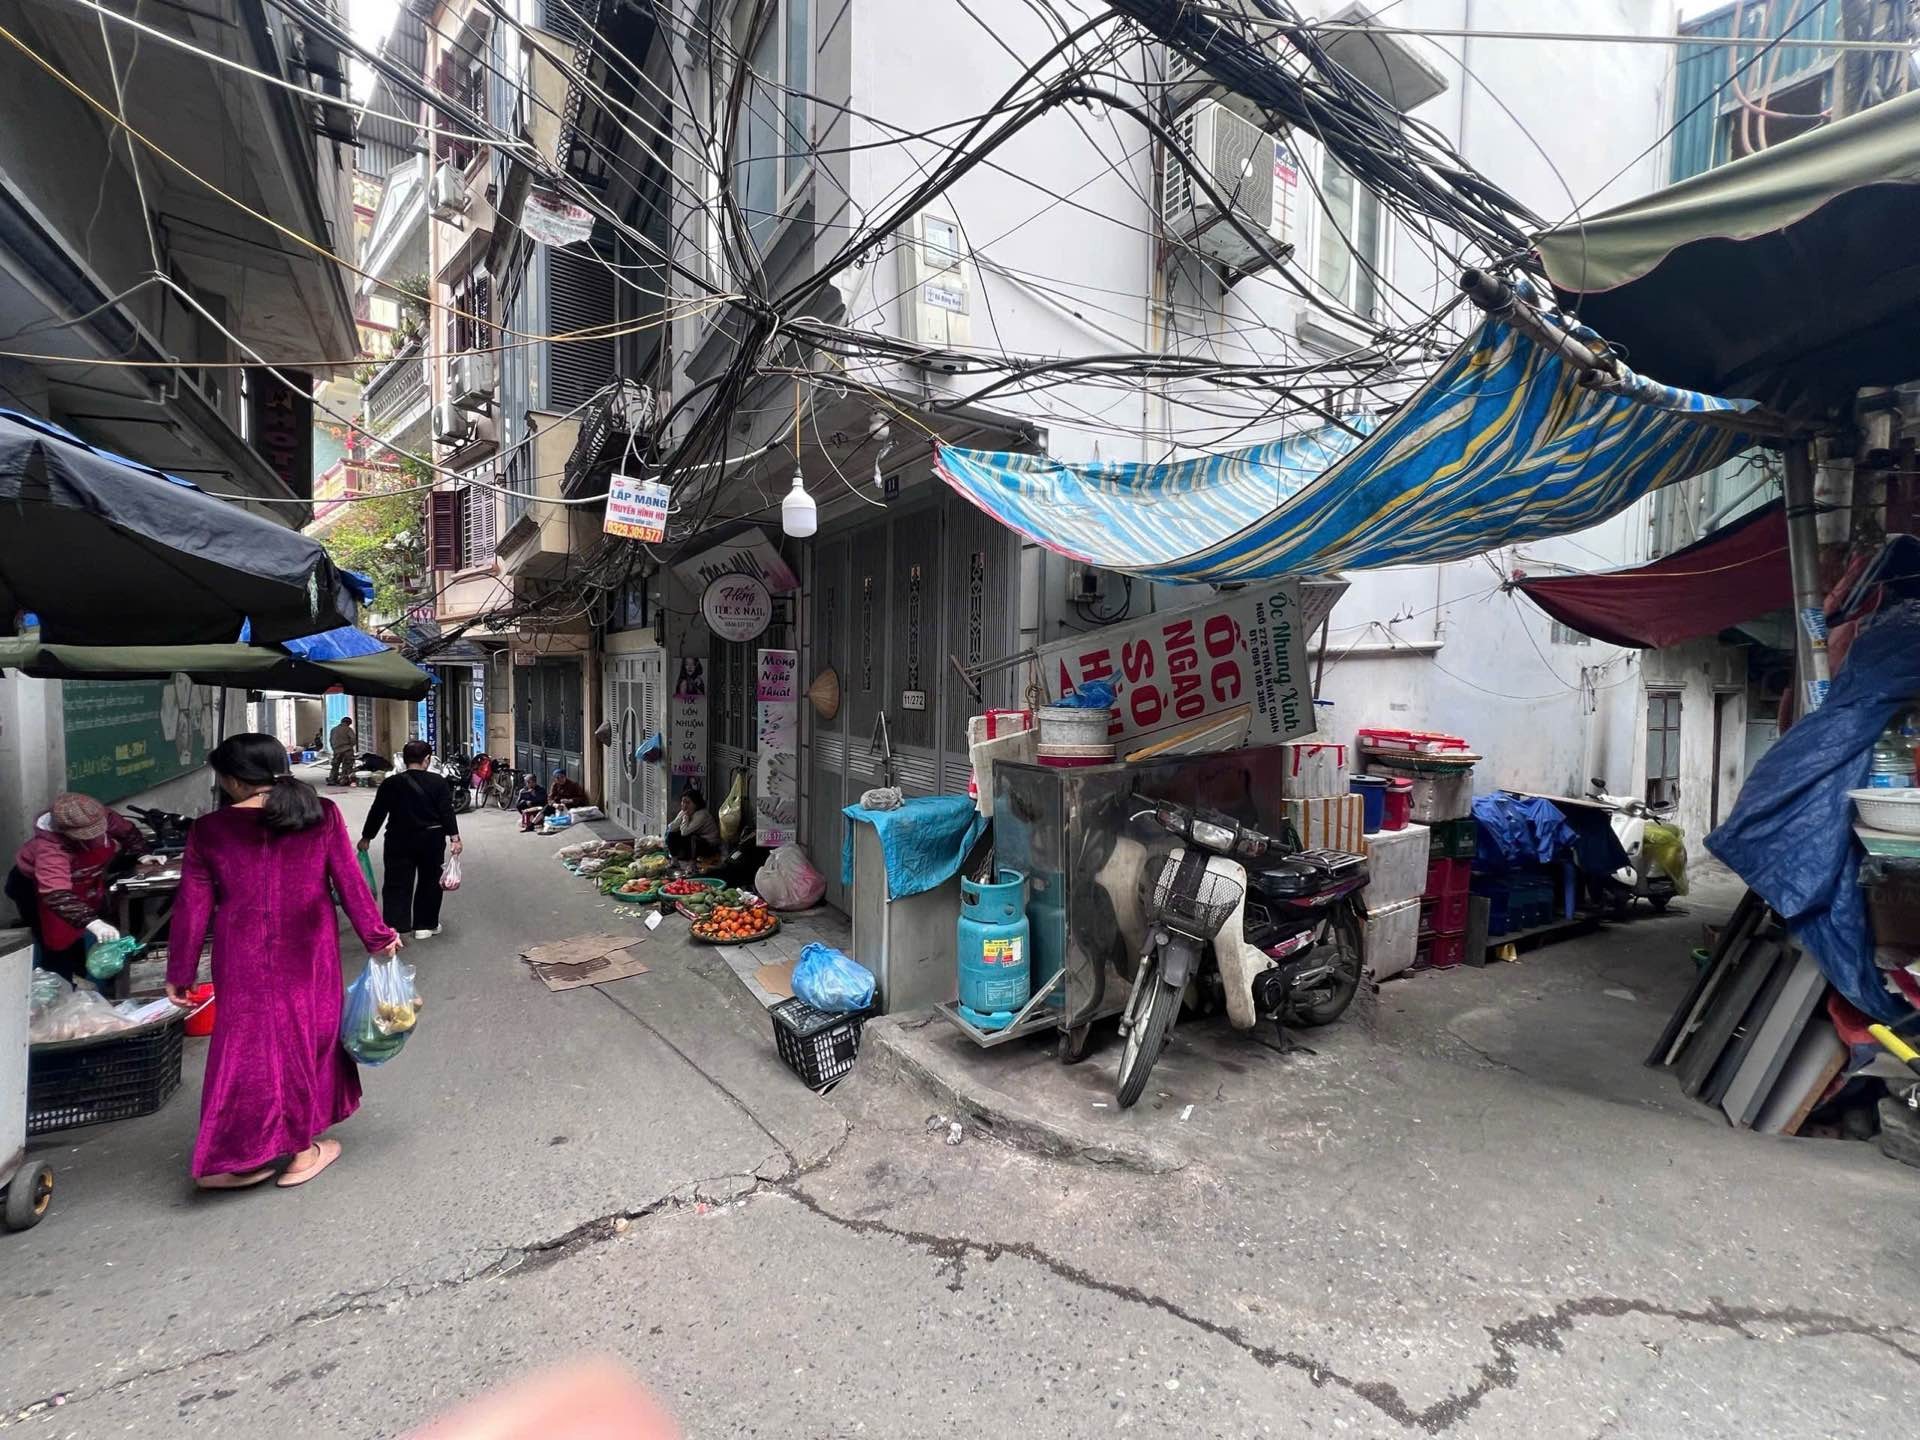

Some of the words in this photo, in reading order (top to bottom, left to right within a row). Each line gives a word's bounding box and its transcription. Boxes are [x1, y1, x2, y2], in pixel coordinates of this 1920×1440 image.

[634, 494, 667, 509] MẠNG
[655, 511, 665, 521] HD
[1204, 614, 1248, 702] ỐC
[1258, 628, 1268, 647] 272
[1272, 621, 1292, 688] Nhung
[1121, 639, 1168, 728] SÒ
[1162, 619, 1205, 720] NGAO
[904, 694, 924, 706] 11/272
[1280, 687, 1300, 734] Xinh
